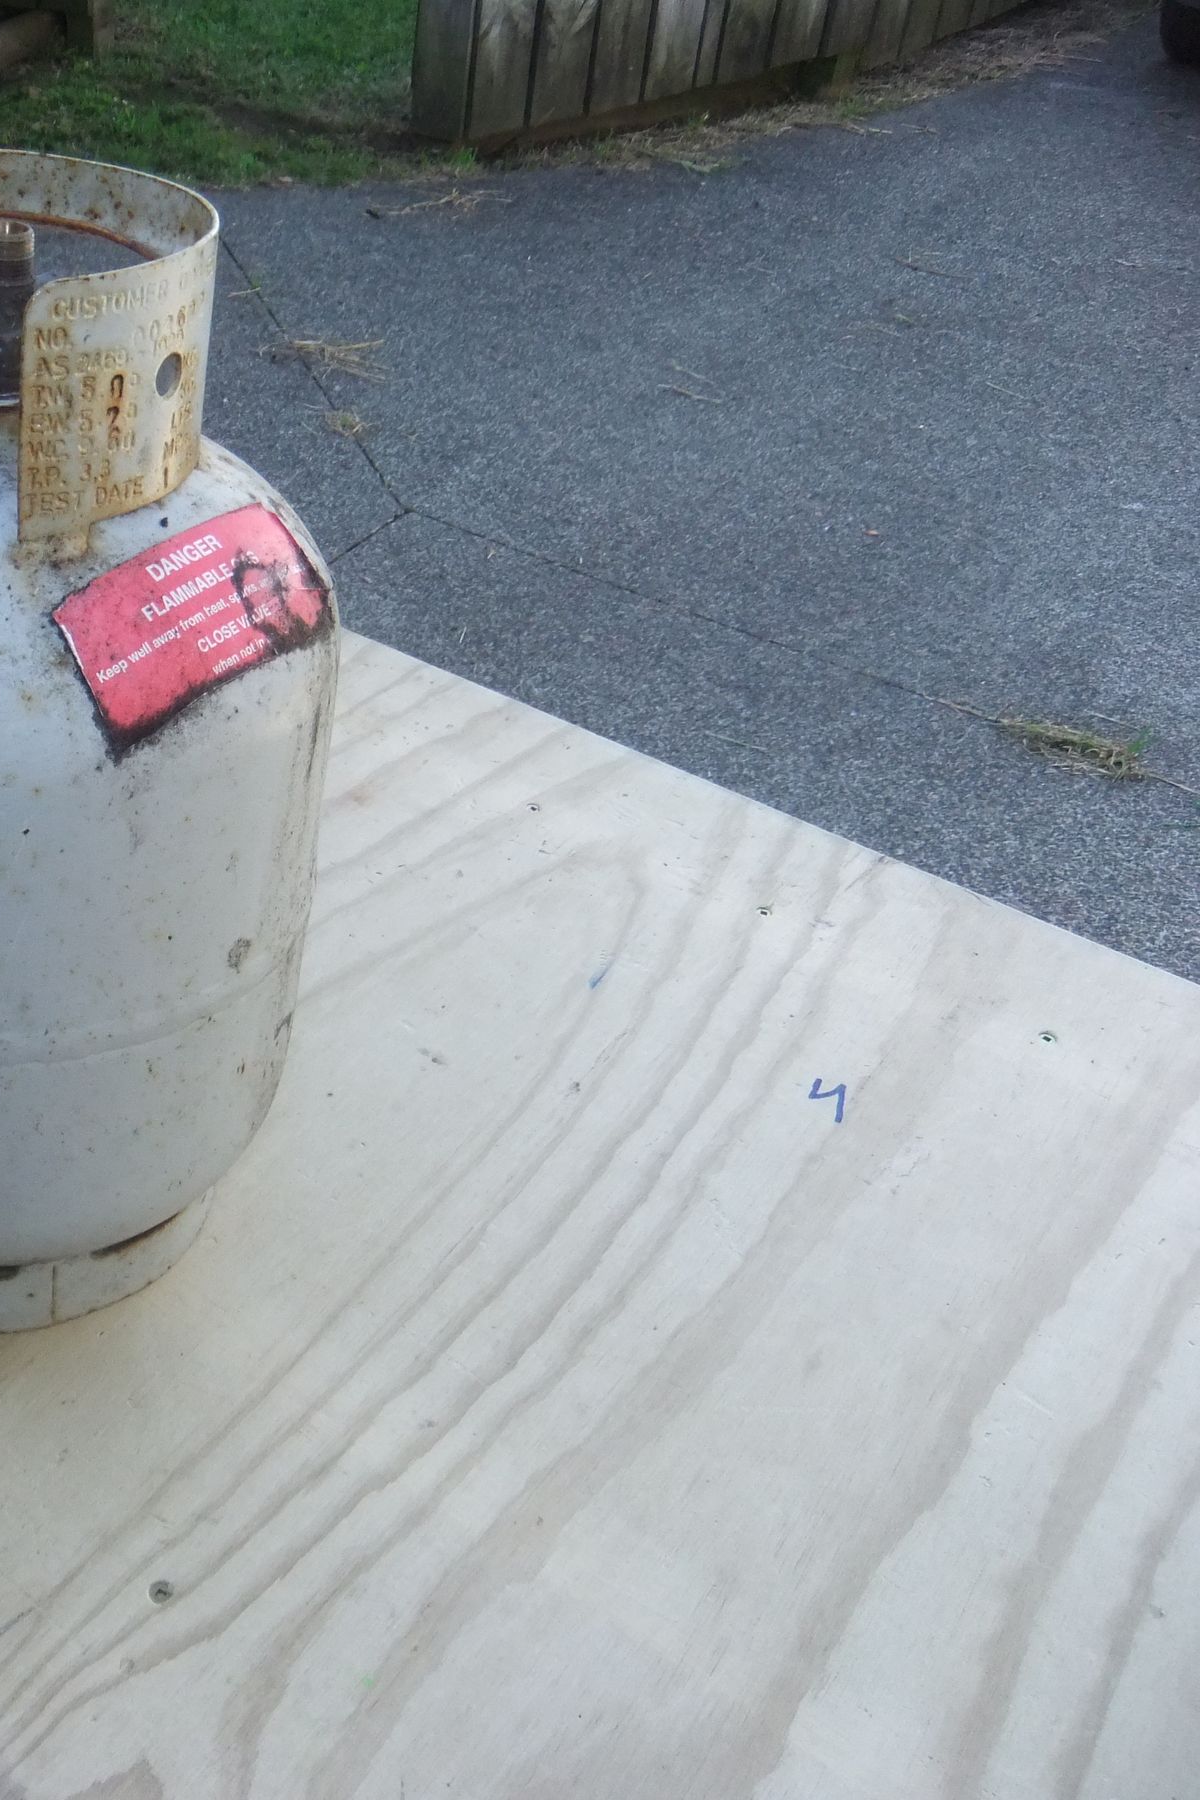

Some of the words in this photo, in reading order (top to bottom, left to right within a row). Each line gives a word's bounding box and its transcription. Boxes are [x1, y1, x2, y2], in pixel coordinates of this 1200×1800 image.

[52, 279, 169, 320] CUSTOMER
[30, 356, 70, 380] AS
[21, 490, 86, 520] TEST
[95, 475, 146, 507] DATE
[145, 534, 223, 582] DANGER
[141, 562, 234, 622] FLAMMABLE
[96, 658, 128, 684] Keep
[128, 642, 152, 667] well
[152, 625, 181, 650] away
[179, 612, 205, 635] from
[204, 596, 230, 619] heat,
[197, 621, 240, 654] CLOSE
[211, 651, 240, 676] when
[239, 641, 257, 660] not
[808, 1078, 847, 1123] 4
